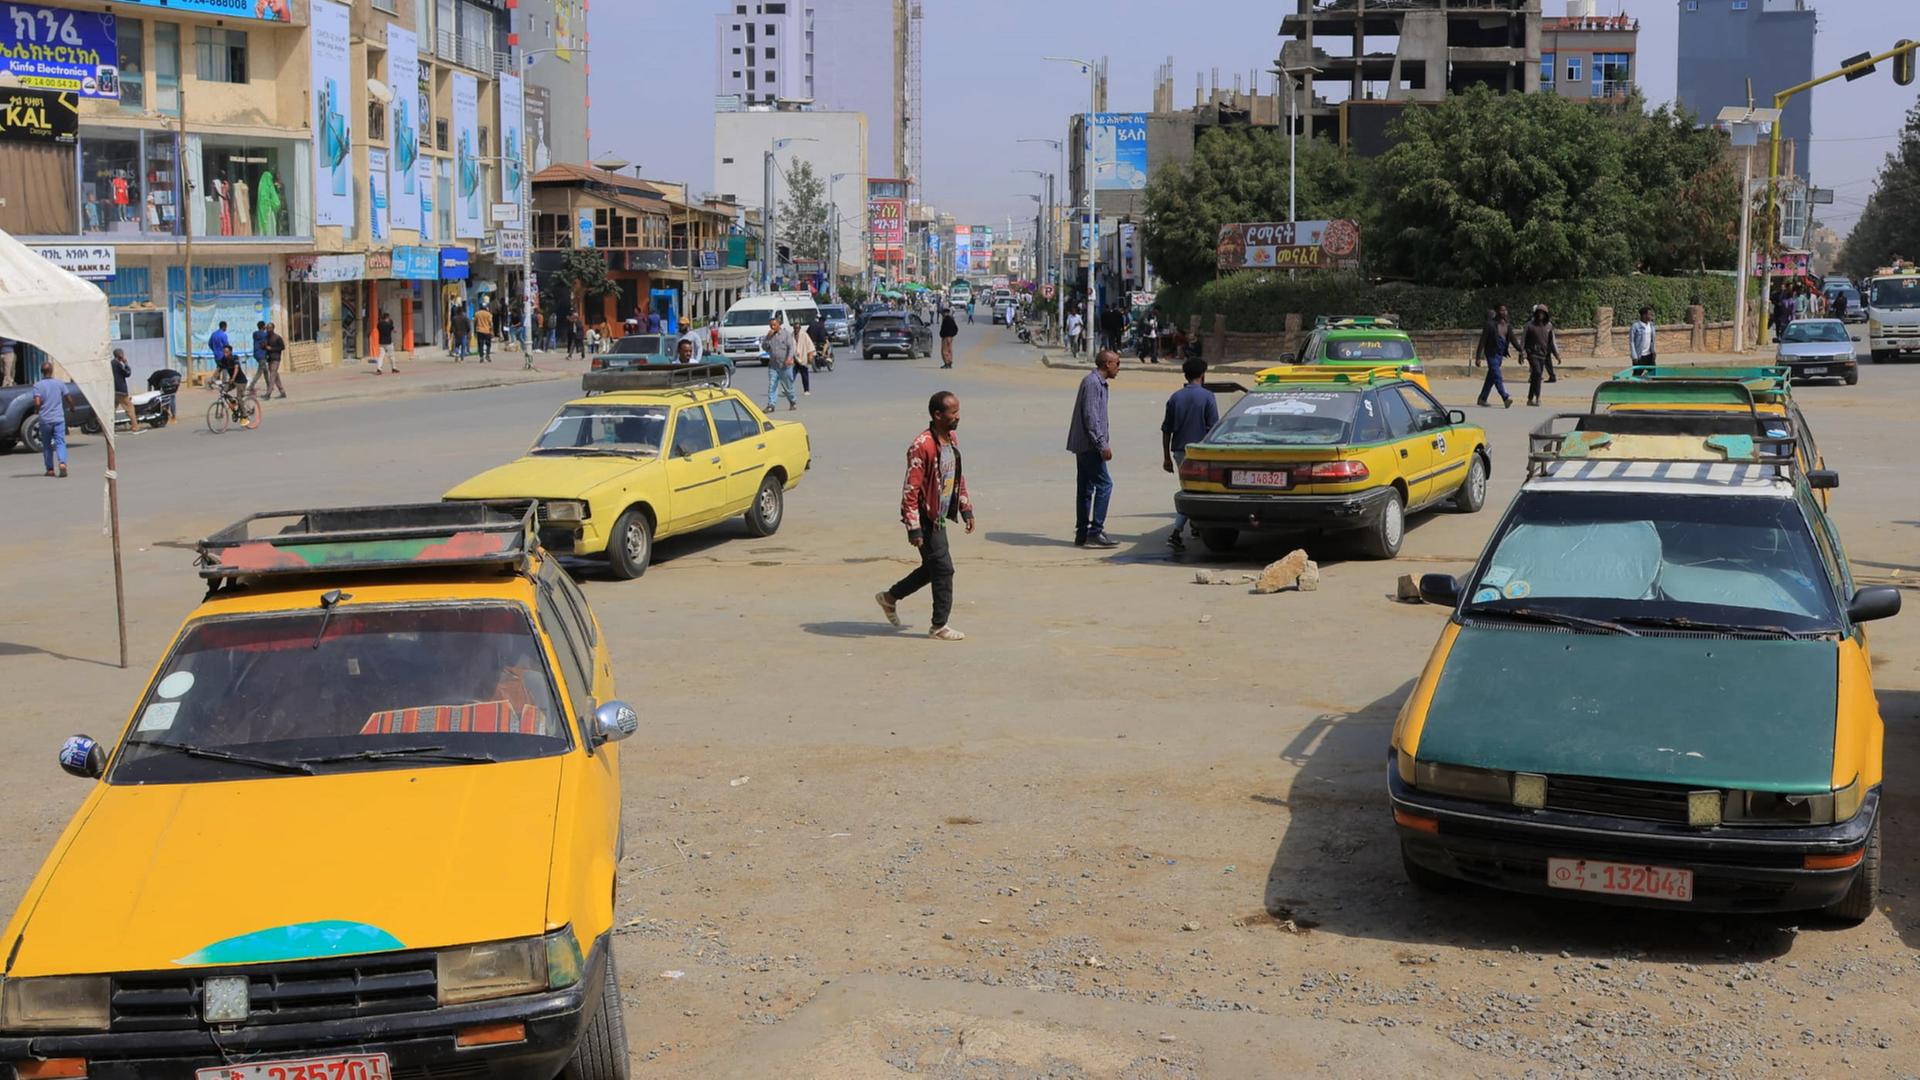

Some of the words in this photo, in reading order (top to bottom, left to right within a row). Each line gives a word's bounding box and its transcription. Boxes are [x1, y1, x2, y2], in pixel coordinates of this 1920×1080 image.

[9, 6, 83, 46] ክንፈ
[9, 60, 35, 72] Kinfe
[37, 63, 88, 76] Electronics
[6, 106, 52, 129] KAL
[77, 264, 98, 272] BANK
[1603, 866, 1675, 895] 13204
